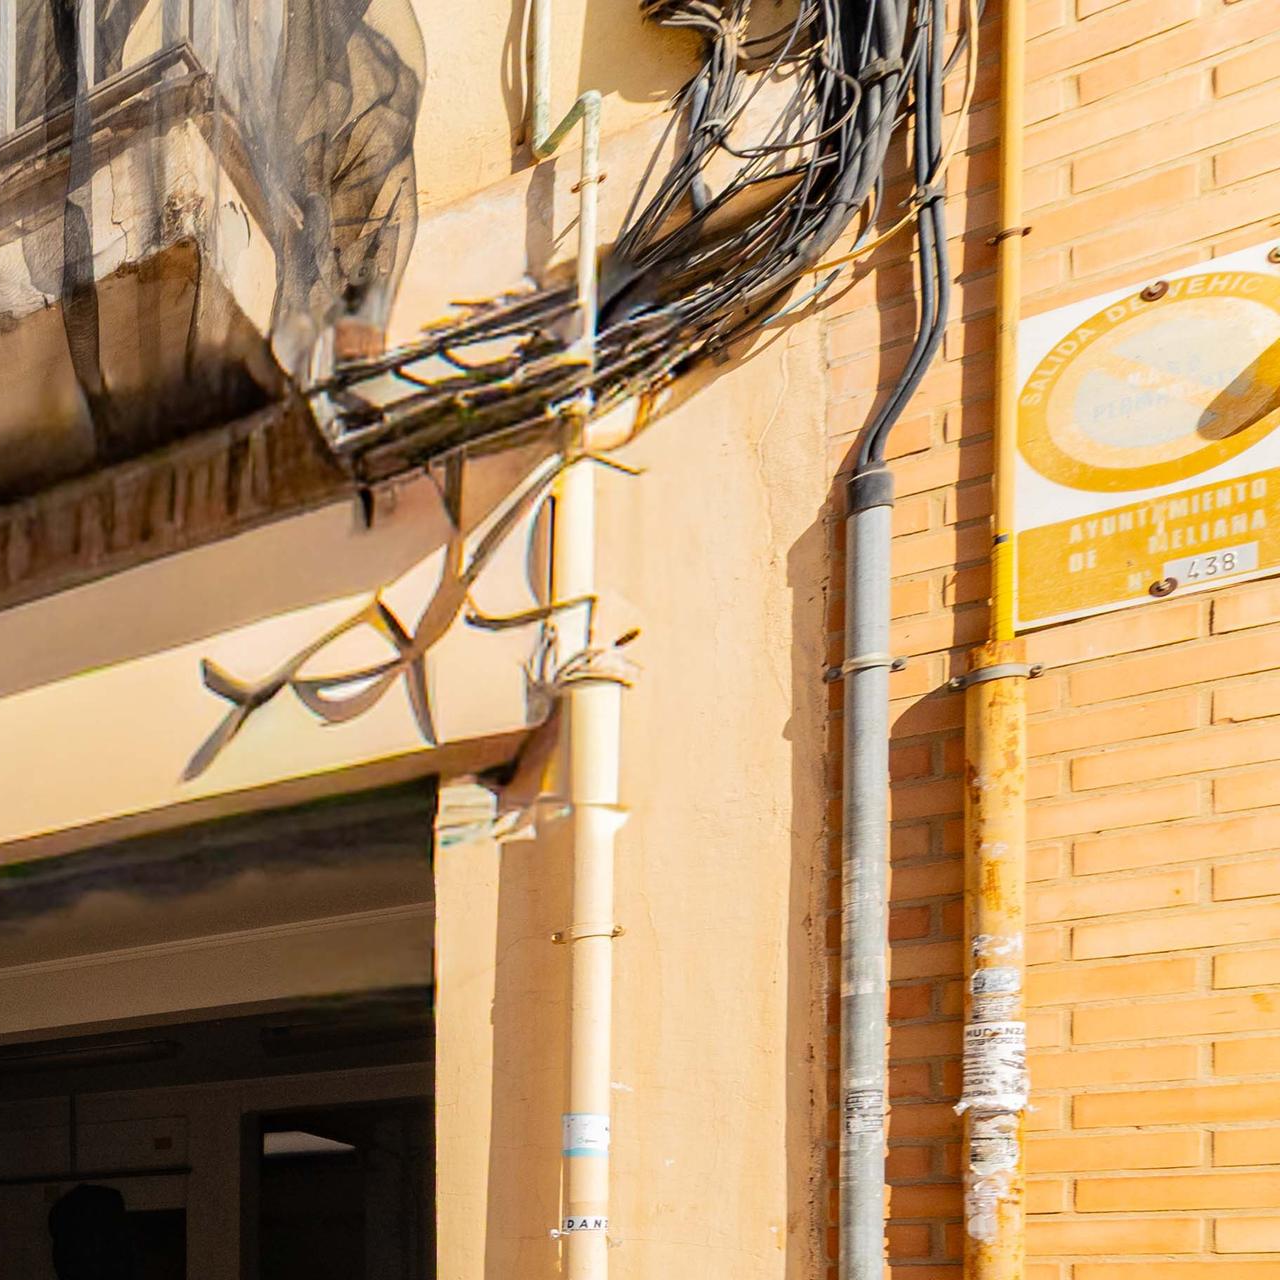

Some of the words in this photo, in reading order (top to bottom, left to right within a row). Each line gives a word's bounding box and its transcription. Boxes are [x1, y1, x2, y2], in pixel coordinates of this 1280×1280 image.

[1023, 327, 1096, 406] SALIDA
[1105, 298, 1148, 323] DE
[1068, 478, 1267, 544] AYUNTAMIENTO
[1068, 549, 1097, 573] DE
[1188, 552, 1235, 578] 438
